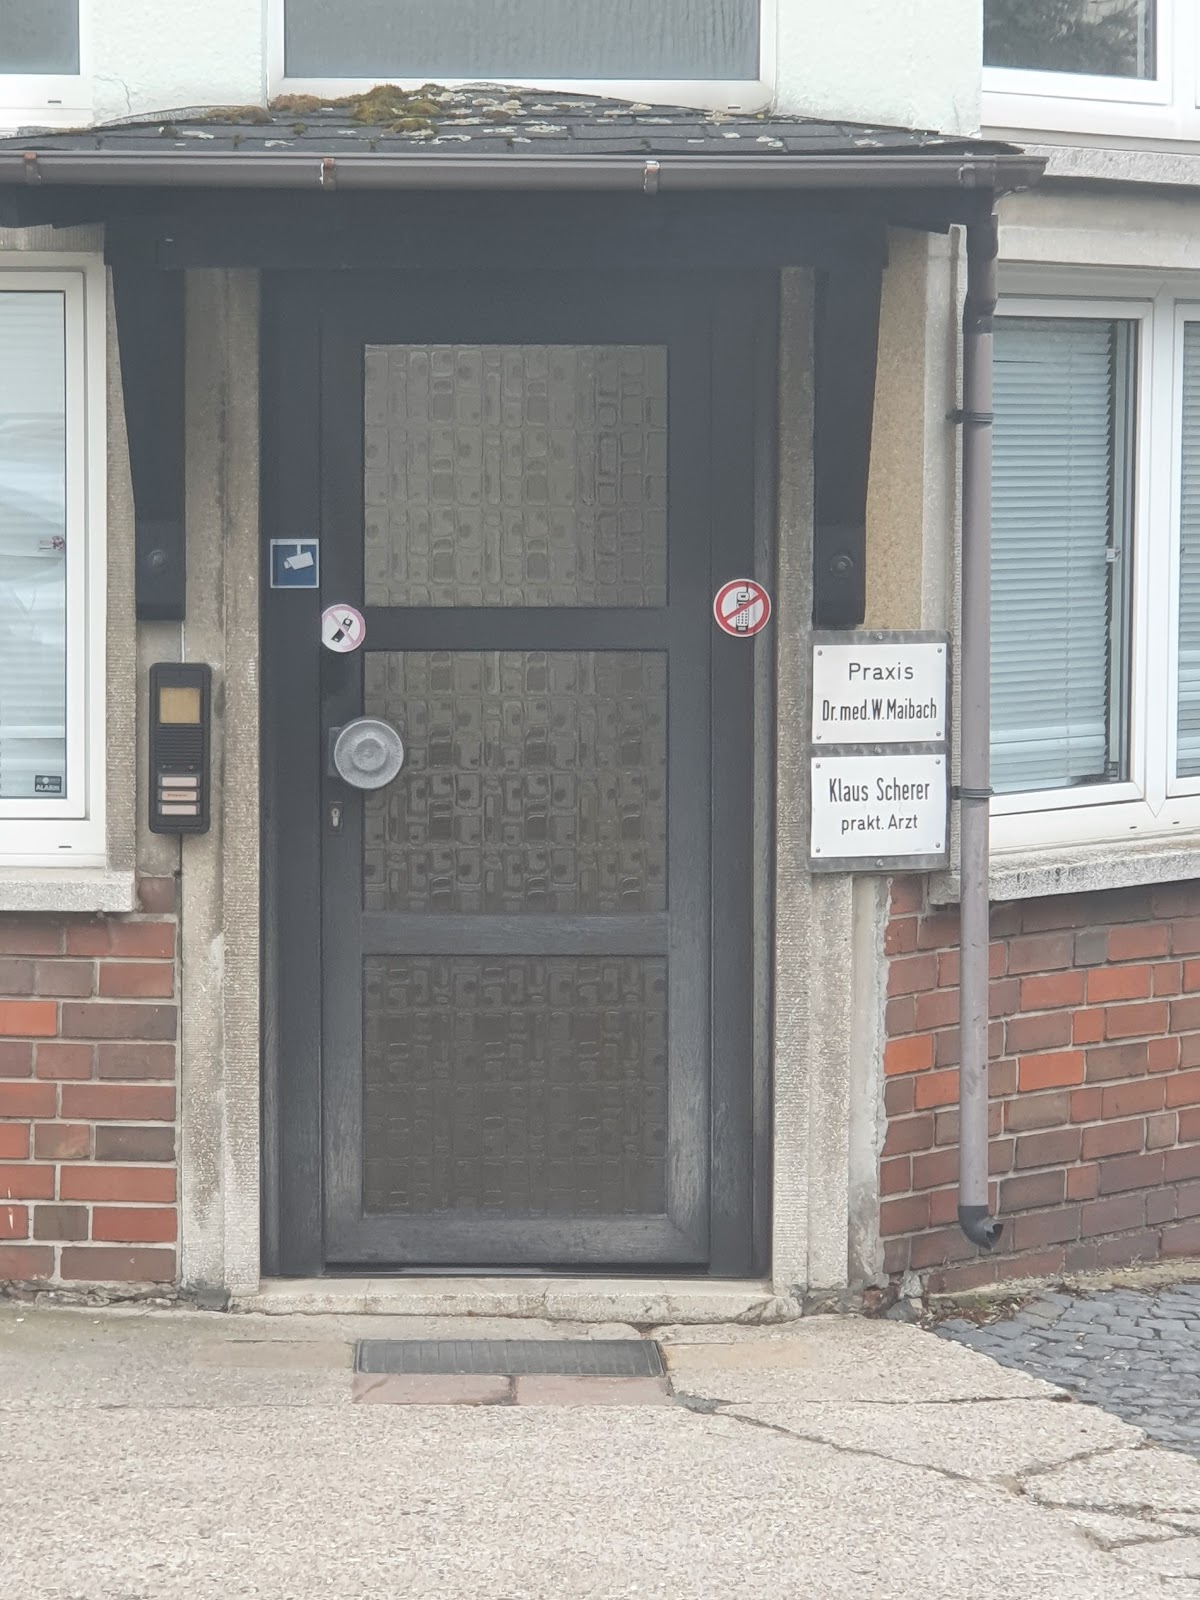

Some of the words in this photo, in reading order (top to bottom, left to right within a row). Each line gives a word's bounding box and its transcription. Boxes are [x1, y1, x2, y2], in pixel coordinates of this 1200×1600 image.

[848, 661, 914, 681] Praxis
[829, 778, 869, 803] Klaus
[876, 776, 930, 801] Scherer
[841, 814, 884, 835] prakt.
[887, 814, 918, 830] Arzt
